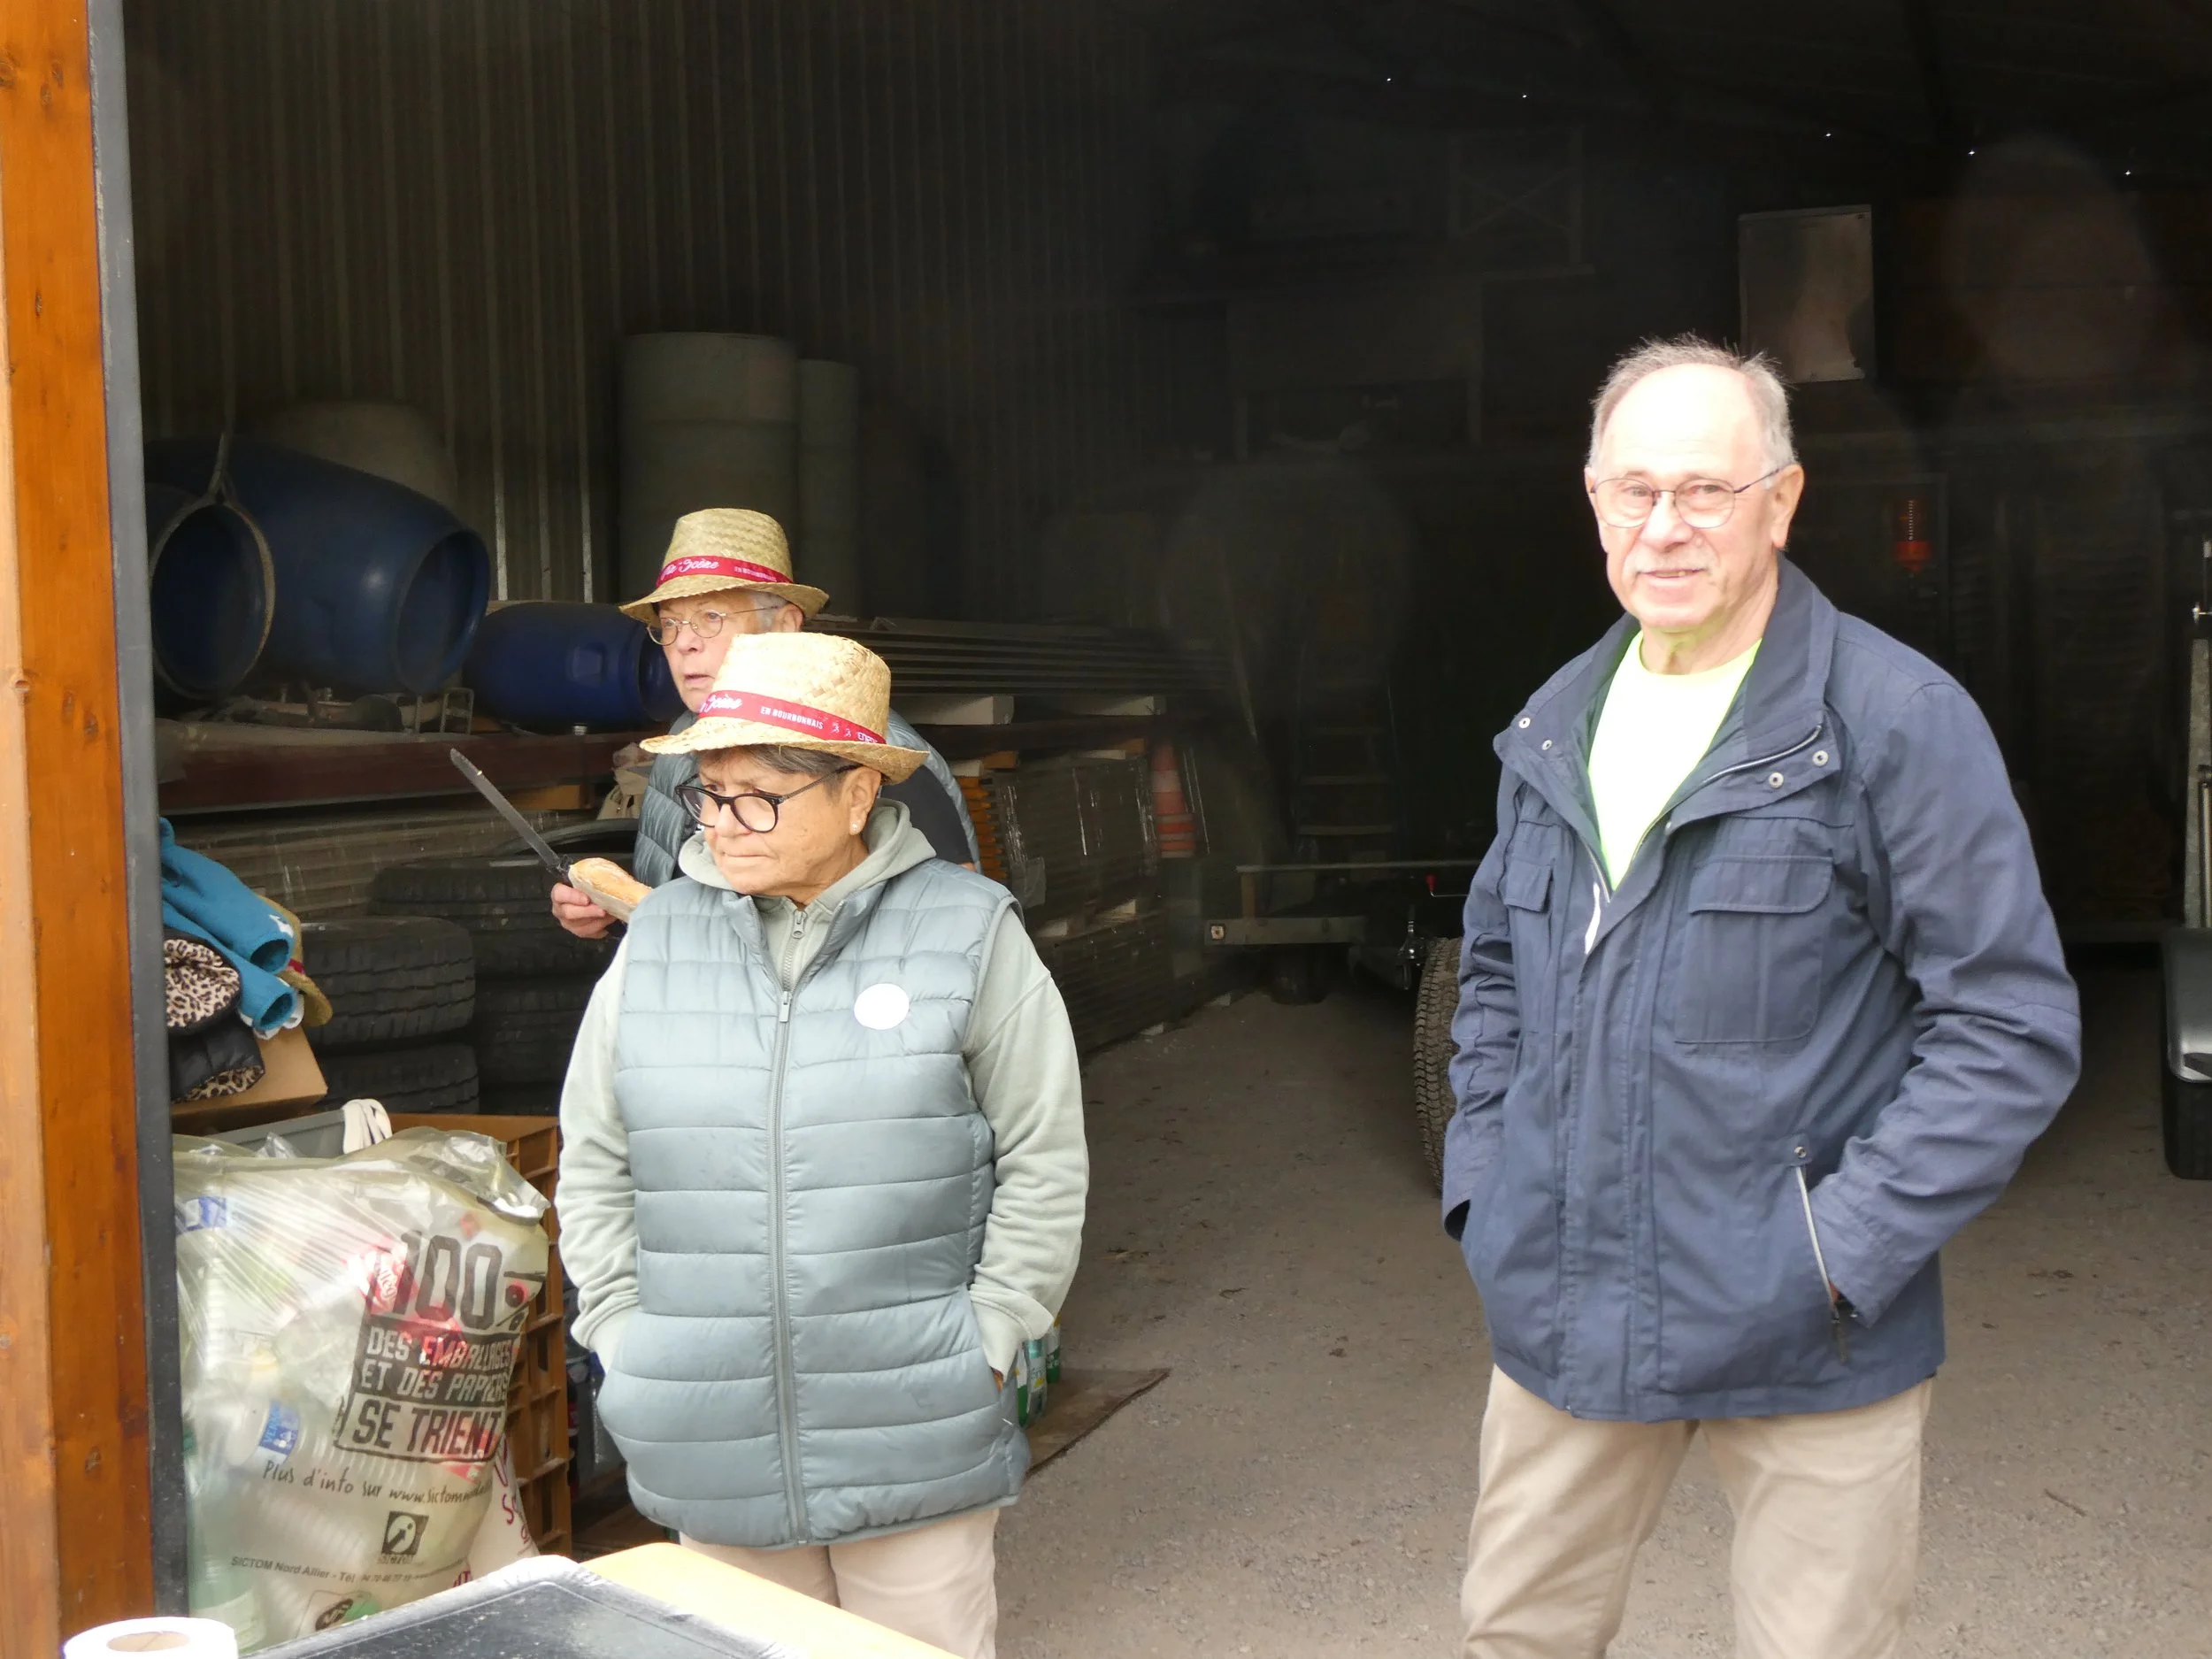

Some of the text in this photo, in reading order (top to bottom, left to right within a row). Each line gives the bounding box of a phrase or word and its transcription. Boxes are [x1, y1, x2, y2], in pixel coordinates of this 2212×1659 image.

[760, 706, 772, 715] EN
[772, 708, 824, 730] BOURBONNAIS
[367, 1326, 512, 1371] DES EMBALLAGES
[361, 1358, 509, 1402] ET DES PAPIERS
[352, 1398, 503, 1458] SE TRIENT
[262, 1460, 295, 1484] Plus
[303, 1466, 354, 1494] d'info
[362, 1481, 382, 1497] sur
[231, 1555, 273, 1570] SICTOM
[274, 1562, 302, 1574] Nord
[302, 1566, 330, 1578] Allier
